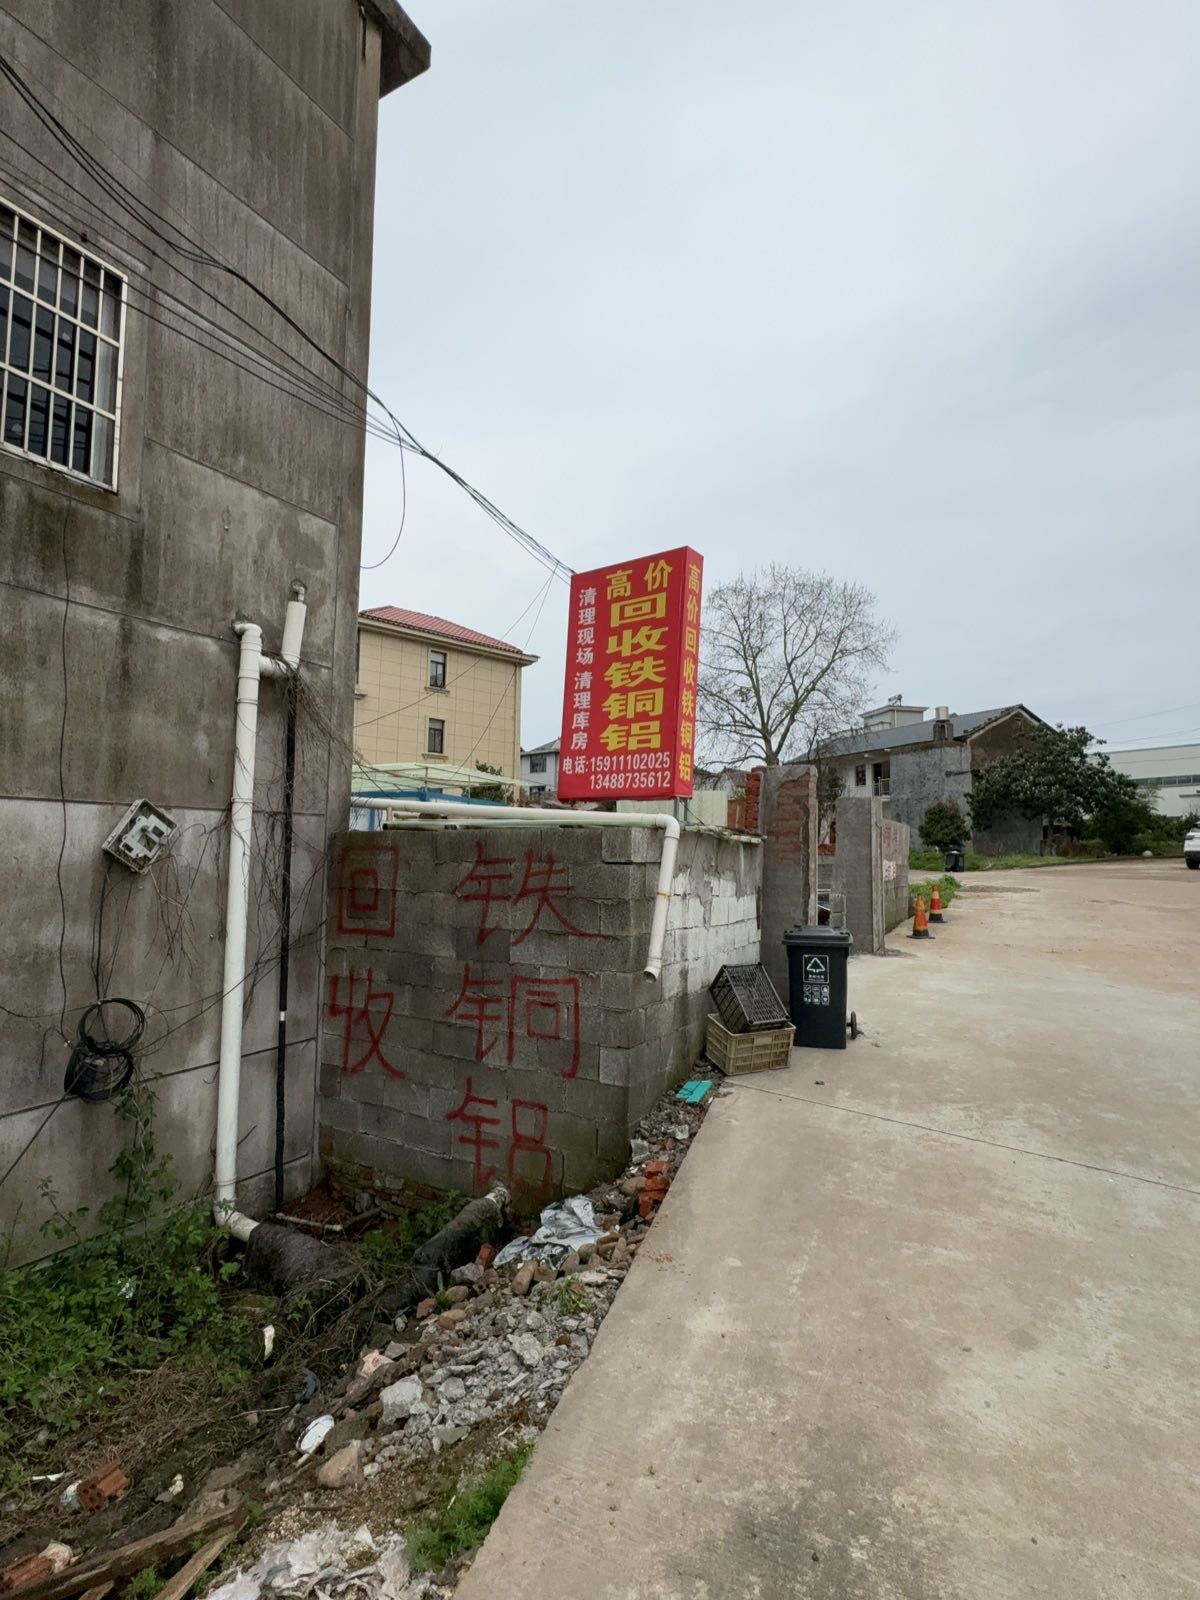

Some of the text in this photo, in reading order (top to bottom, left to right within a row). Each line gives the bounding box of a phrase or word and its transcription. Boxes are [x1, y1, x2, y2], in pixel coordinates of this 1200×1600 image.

[606, 559, 673, 600] 高价
[570, 587, 597, 751] 清理现场 清理库房
[600, 592, 669, 751] 回收铁铜铝
[590, 771, 671, 790] 13488735612
